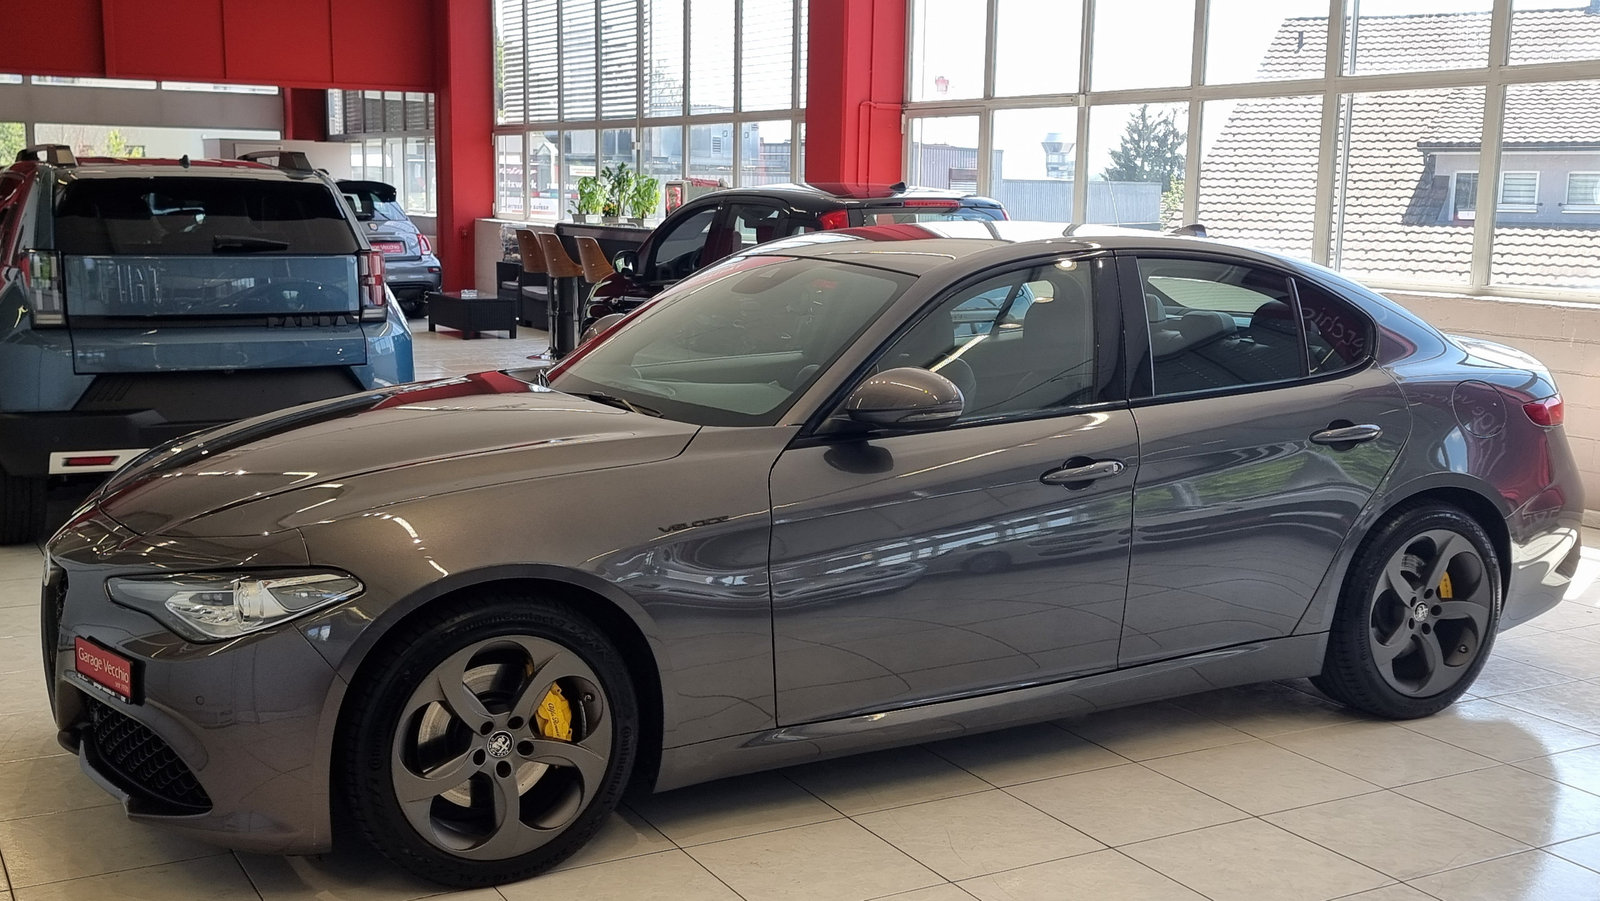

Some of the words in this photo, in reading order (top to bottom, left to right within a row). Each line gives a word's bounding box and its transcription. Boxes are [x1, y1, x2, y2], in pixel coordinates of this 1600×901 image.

[98, 261, 164, 304] FIAT
[267, 315, 348, 328] PANDA
[78, 647, 103, 671] Garage
[102, 658, 129, 683] Vecchio
